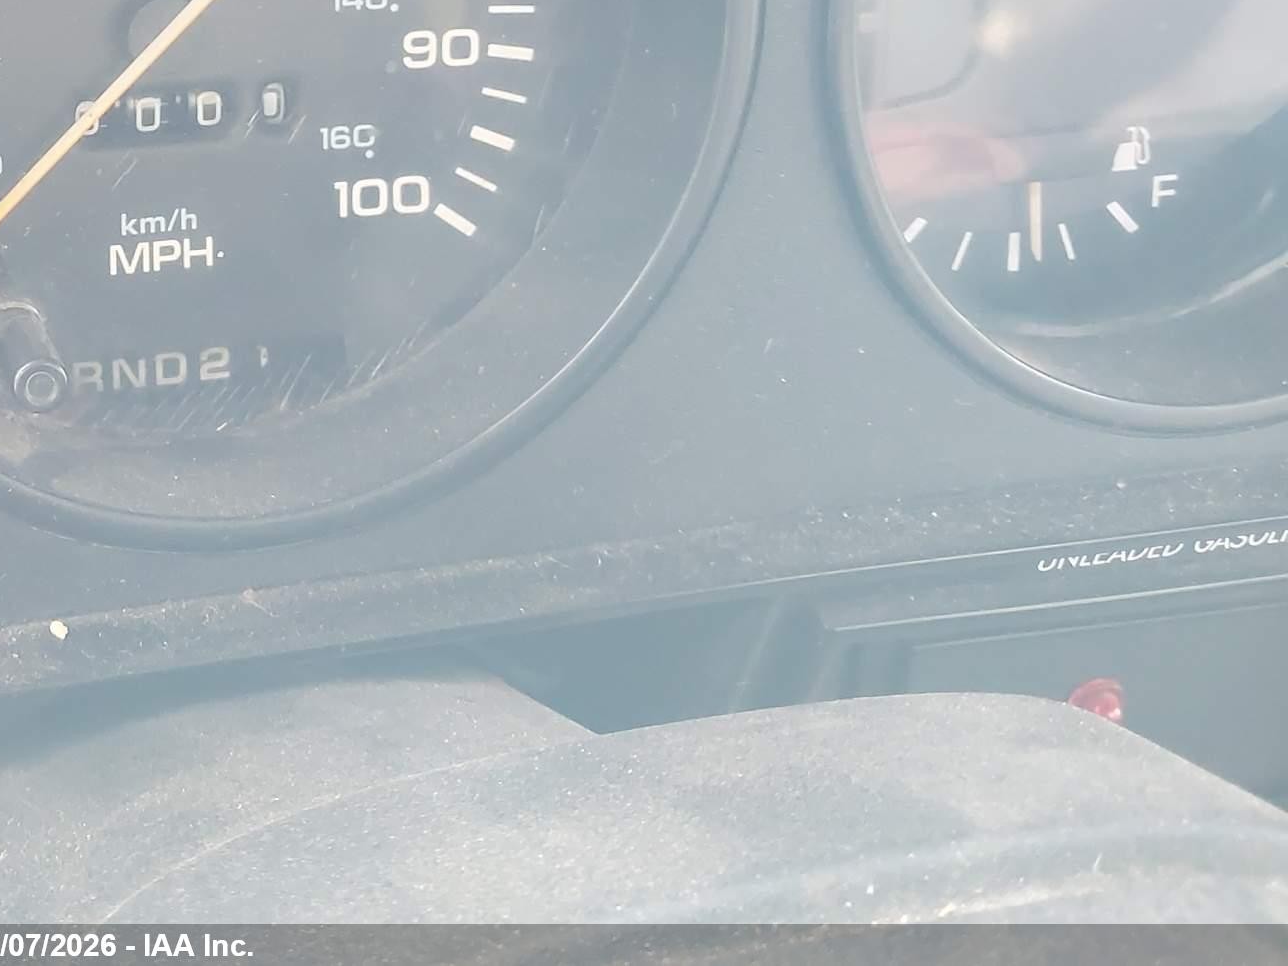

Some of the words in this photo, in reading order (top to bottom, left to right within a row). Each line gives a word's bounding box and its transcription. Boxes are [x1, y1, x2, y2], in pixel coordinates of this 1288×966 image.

[403, 28, 479, 69] 90
[320, 124, 375, 149] 160
[334, 175, 430, 218] 100
[1152, 173, 1178, 207] F
[120, 208, 198, 236] km/h
[109, 235, 214, 276] MPH
